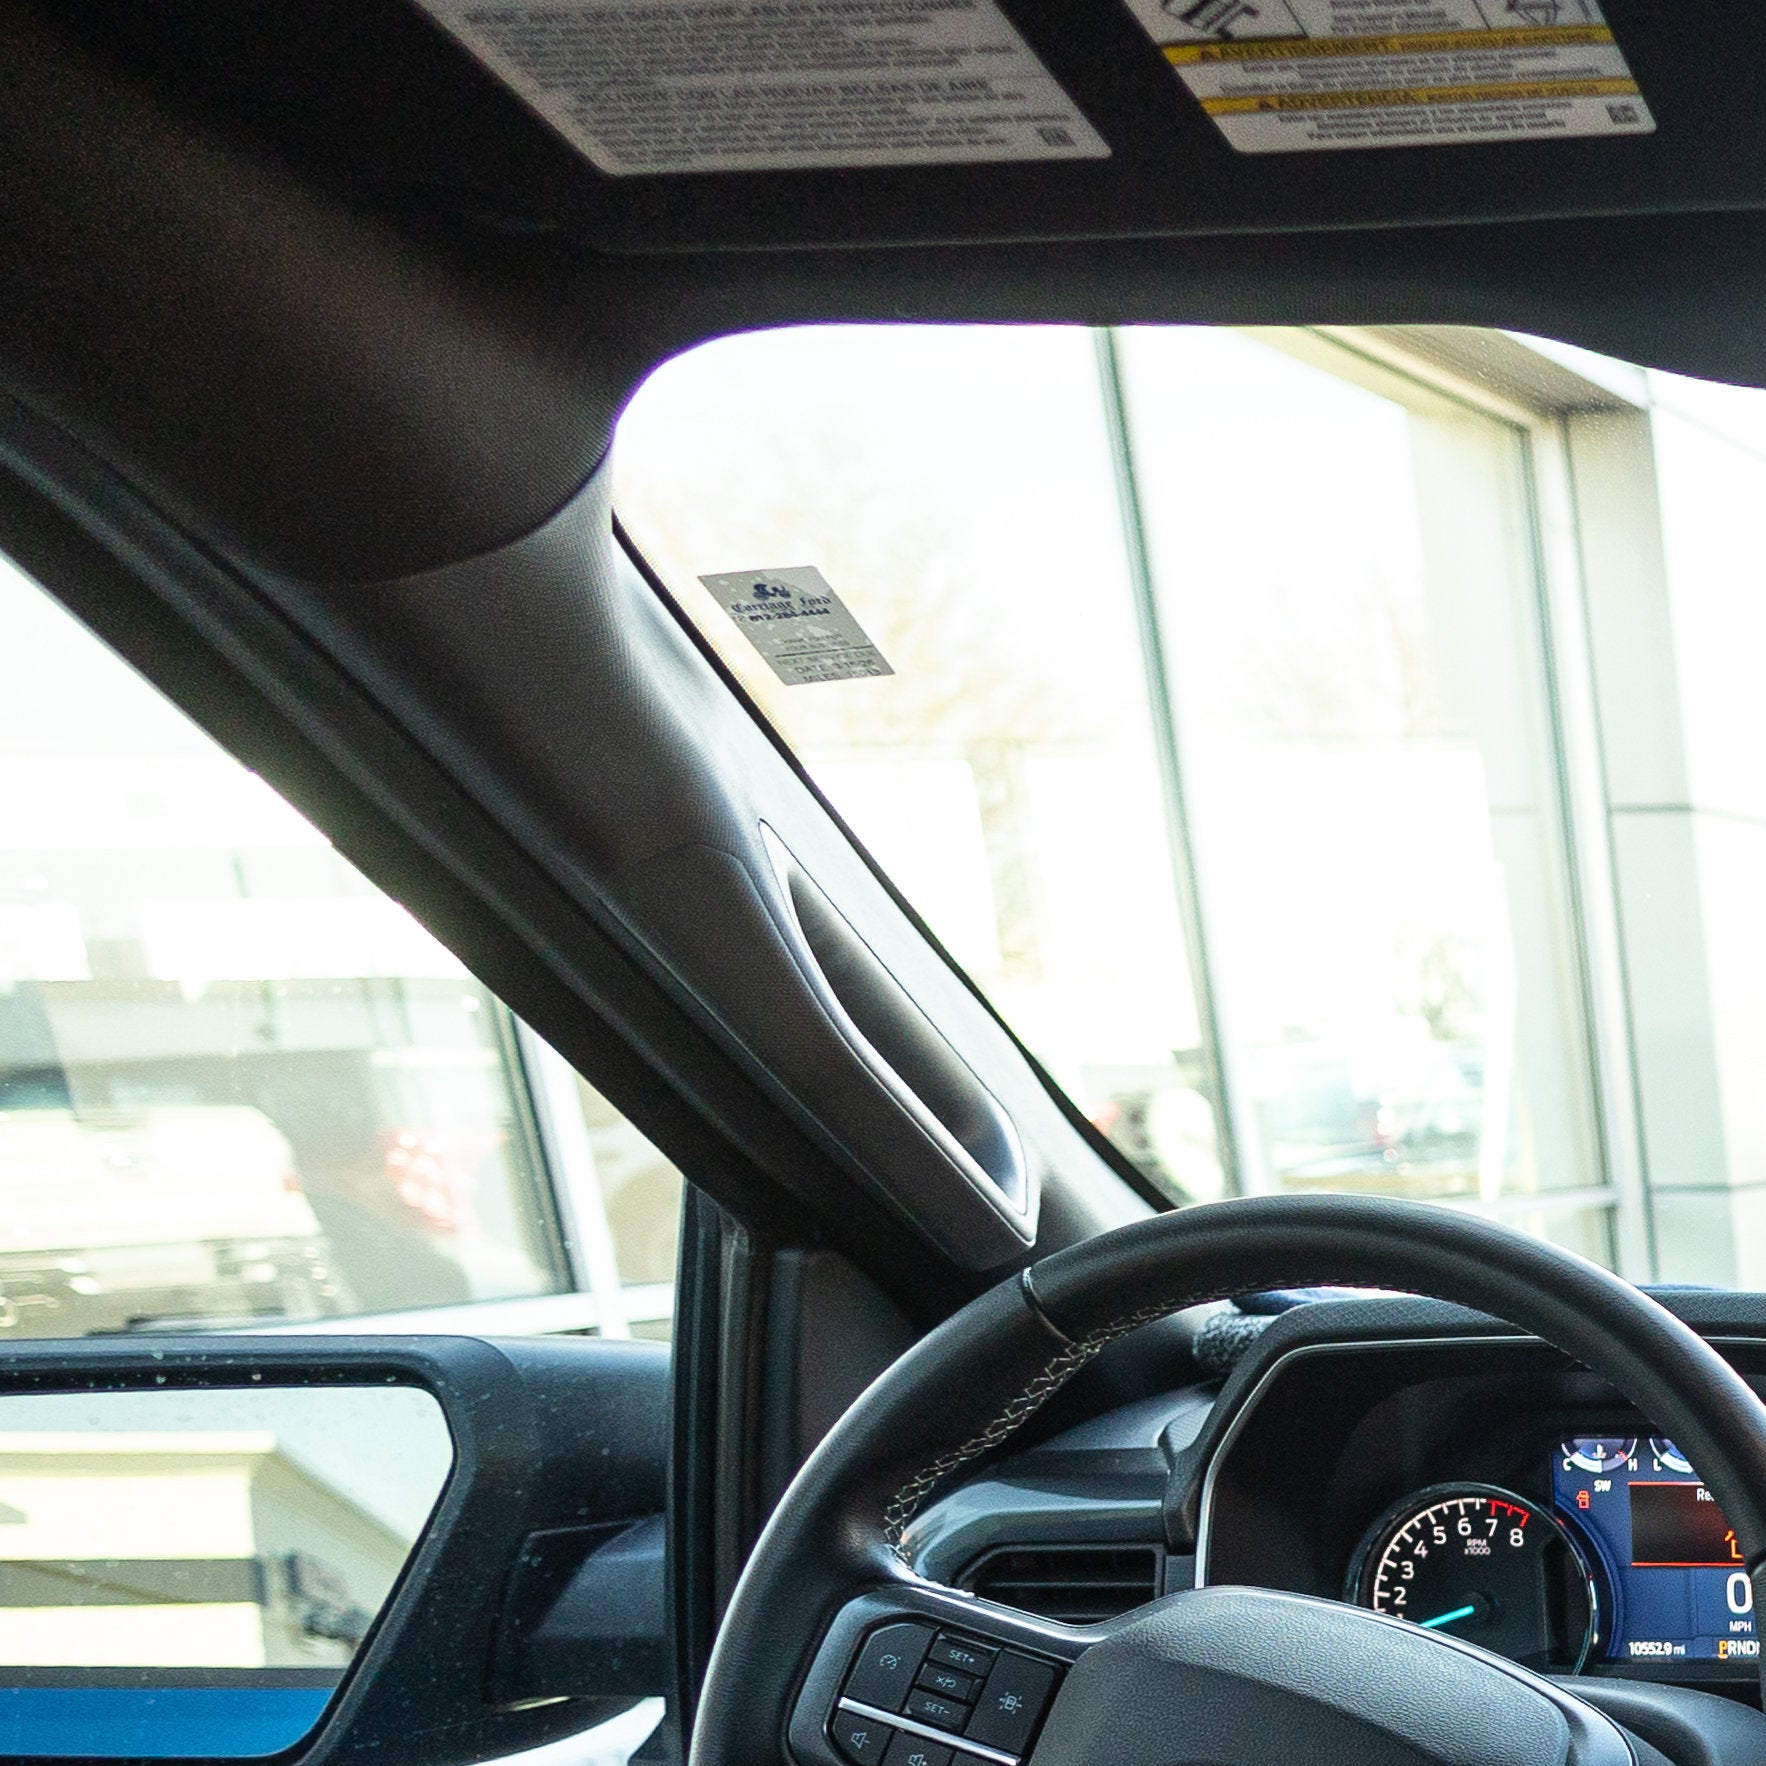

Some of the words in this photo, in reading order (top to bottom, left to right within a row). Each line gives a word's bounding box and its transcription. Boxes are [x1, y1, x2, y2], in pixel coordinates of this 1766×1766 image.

[1563, 1458, 1572, 1471] C
[1628, 1458, 1638, 1471] H
[1653, 1458, 1662, 1471] L
[1593, 1480, 1612, 1492] SW
[1433, 1526, 1447, 1545] 5
[1457, 1517, 1472, 1536] 6
[1485, 1518, 1498, 1537] 7
[1509, 1528, 1524, 1547] 8
[1413, 1540, 1428, 1559] 4
[1401, 1561, 1414, 1579] 3
[1393, 1586, 1407, 1605] 2
[1726, 1572, 1753, 1614] 0
[1729, 1621, 1752, 1632] MPH
[1673, 1644, 1686, 1655] mi
